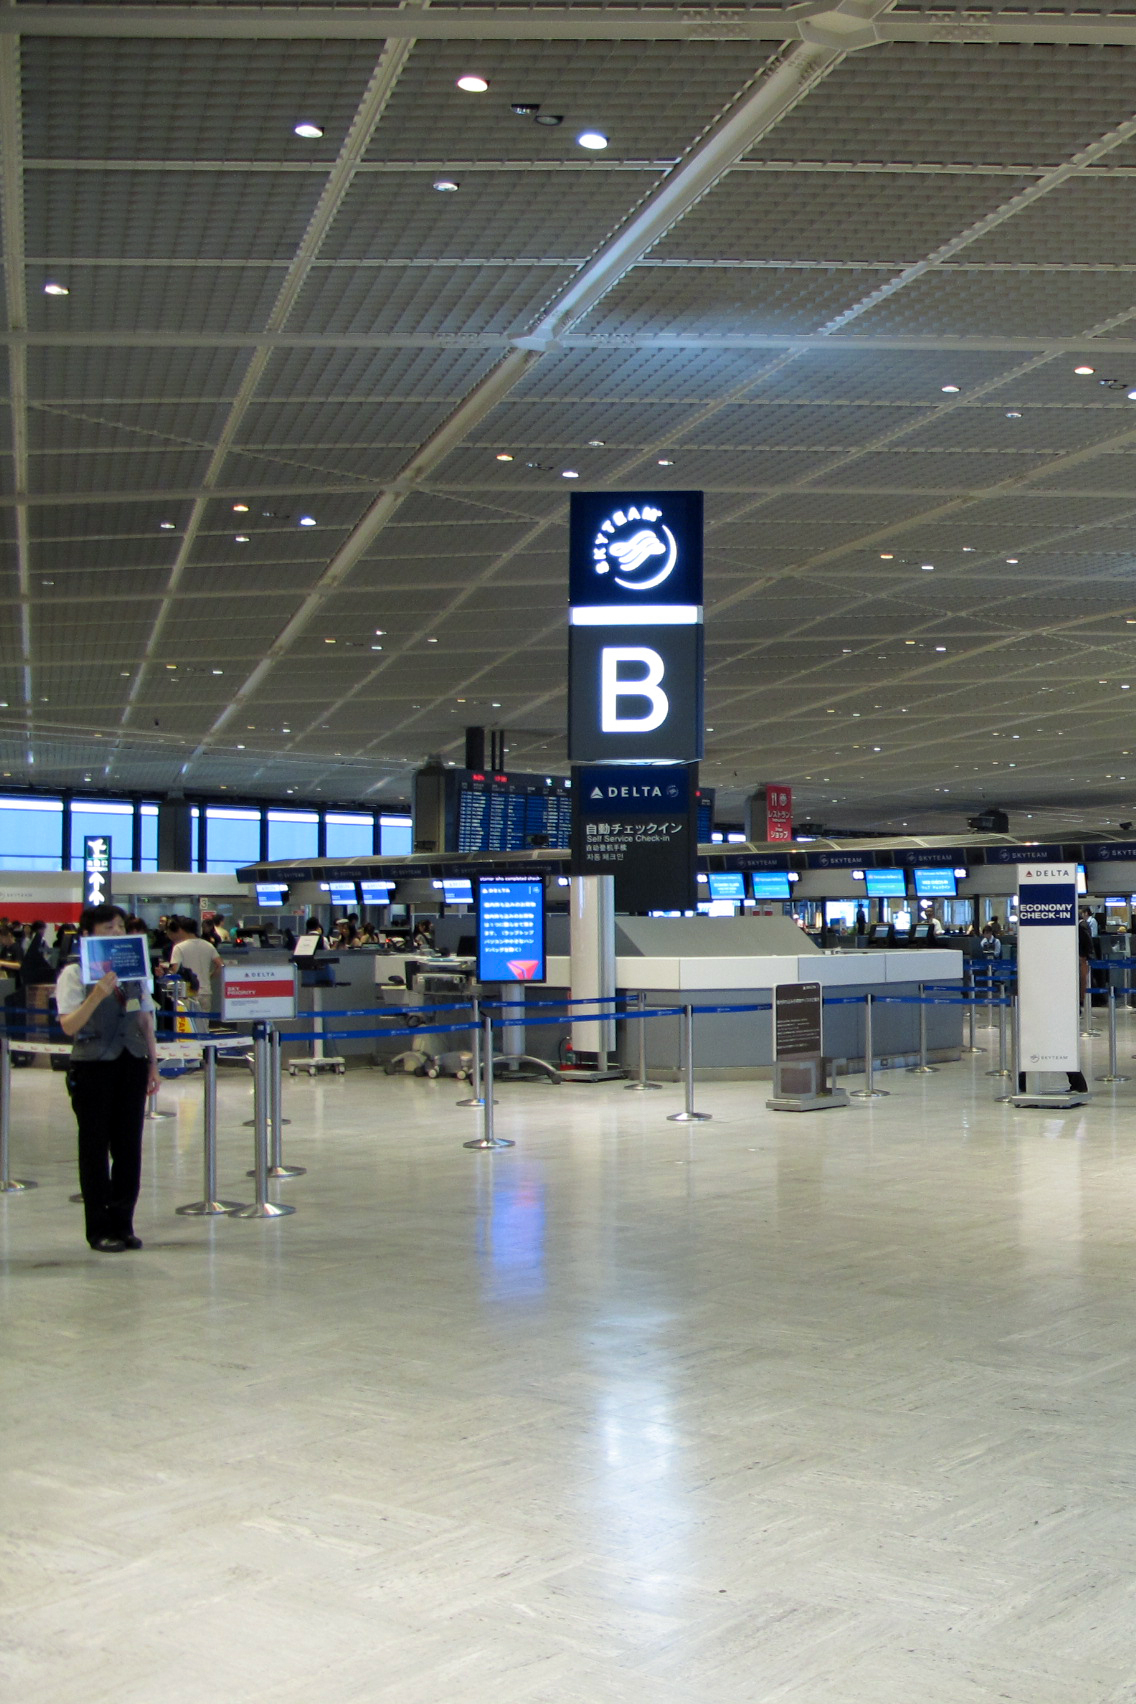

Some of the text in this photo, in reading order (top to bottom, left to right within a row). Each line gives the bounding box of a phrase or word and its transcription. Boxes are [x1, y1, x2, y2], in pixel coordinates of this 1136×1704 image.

[601, 646, 669, 733] B
[608, 786, 662, 797] DELTA
[768, 810, 790, 818] レストラン
[586, 823, 682, 835] 自動チェックイン
[1020, 911, 1071, 919] CHECK-IN
